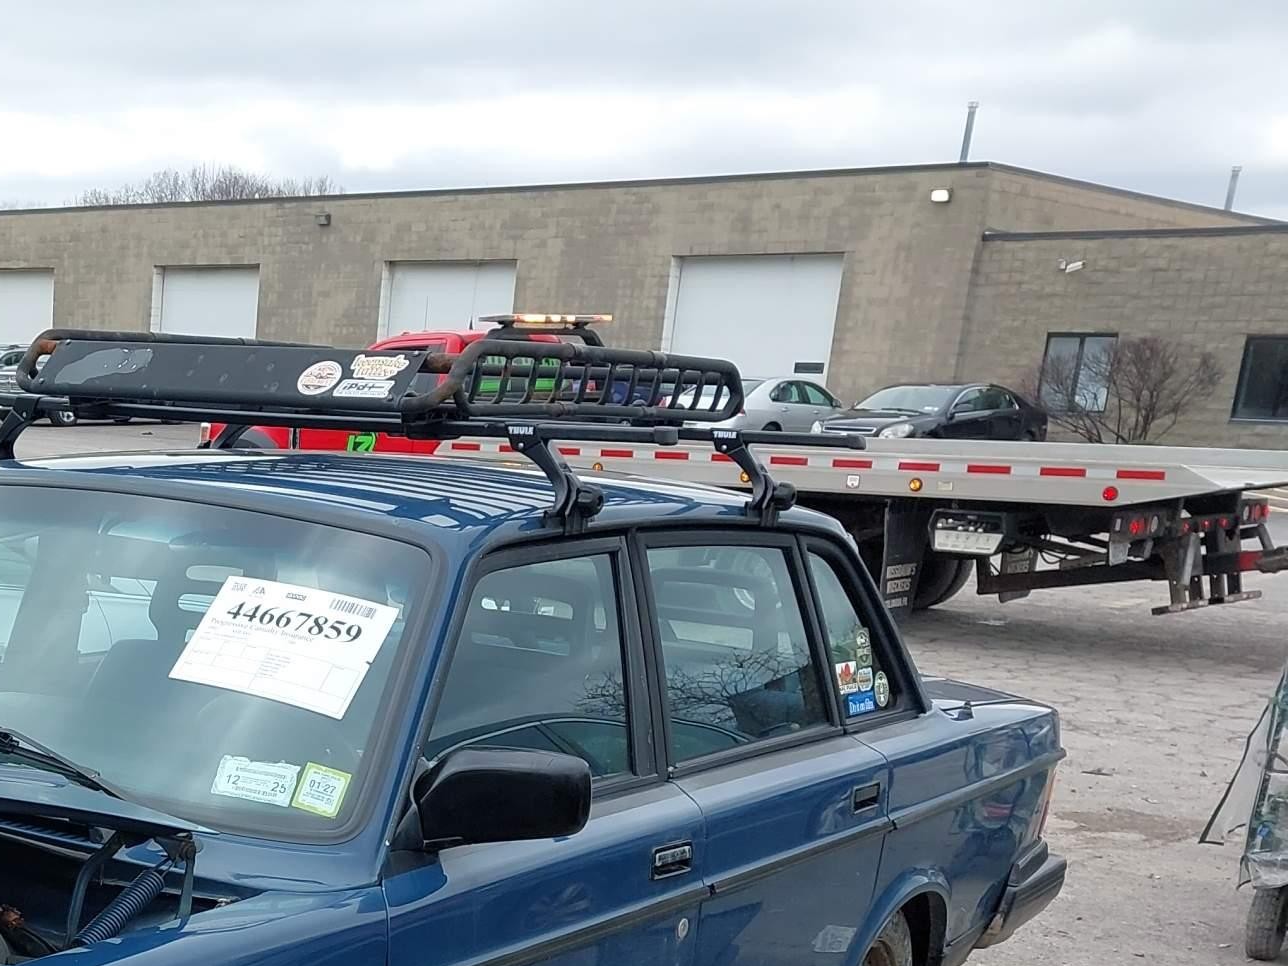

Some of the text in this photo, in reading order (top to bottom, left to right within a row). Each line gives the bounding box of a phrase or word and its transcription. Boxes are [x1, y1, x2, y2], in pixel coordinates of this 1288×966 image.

[508, 426, 534, 435] THULE
[713, 430, 737, 439] THULE
[226, 601, 362, 643] 44667859
[226, 773, 241, 786] 12
[271, 781, 287, 794] 25
